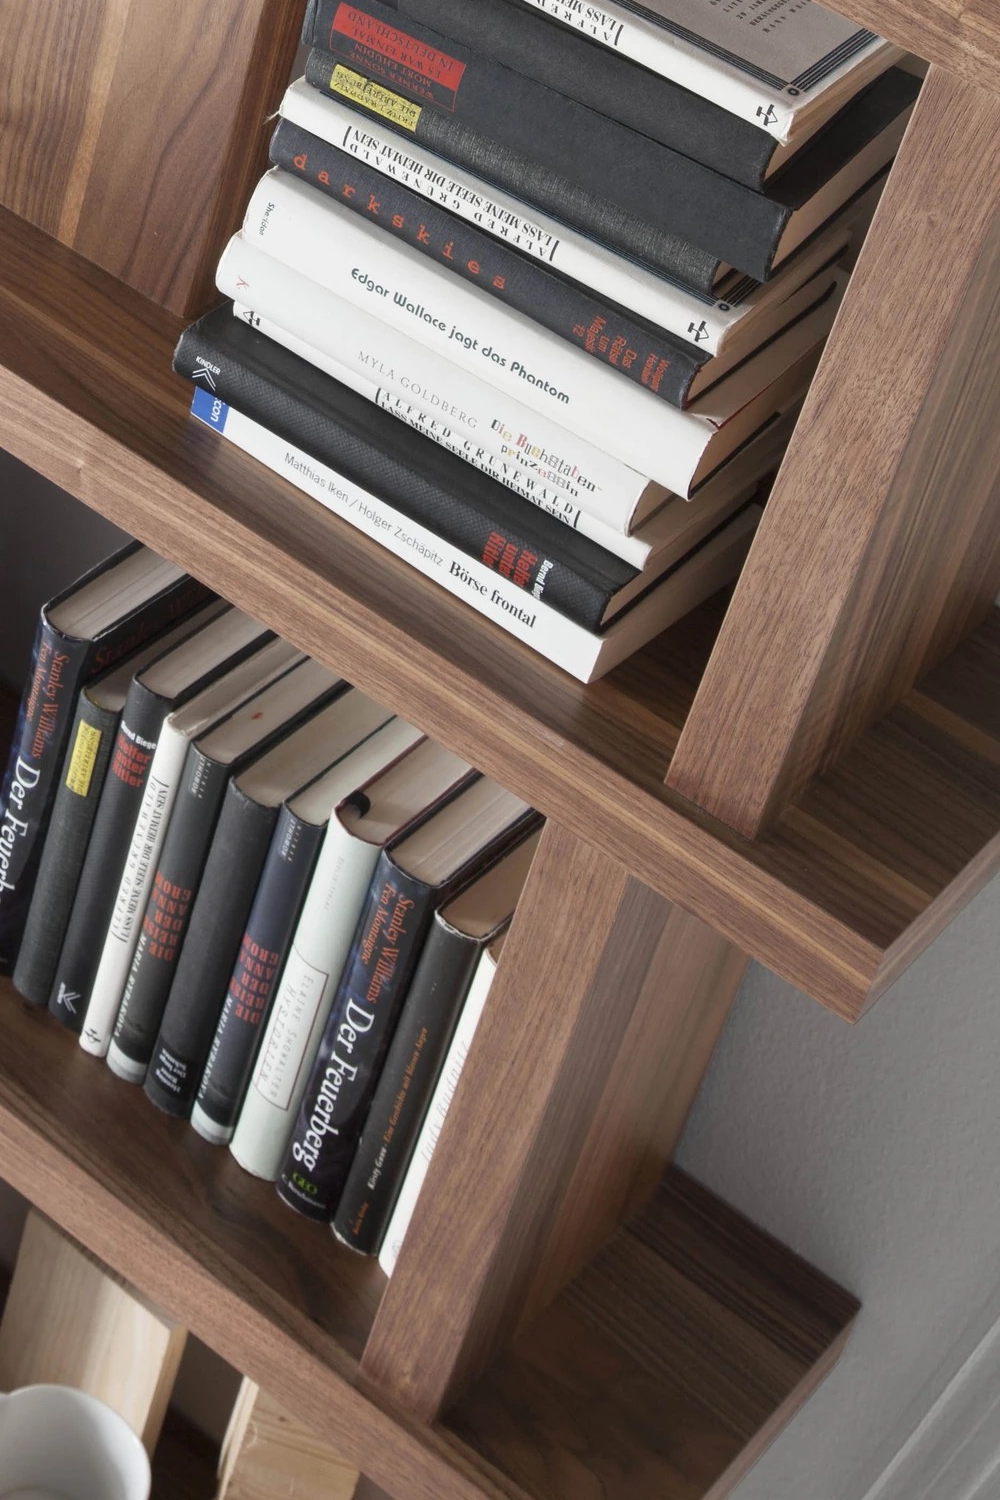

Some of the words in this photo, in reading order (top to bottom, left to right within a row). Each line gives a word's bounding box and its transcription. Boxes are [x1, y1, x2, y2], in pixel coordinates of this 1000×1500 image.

[586, 7, 617, 30] LASS
[348, 11, 438, 63] DEUTSCHLAND
[353, 28, 397, 57] EINMAL
[399, 52, 423, 70] WAR
[426, 64, 441, 79] ES
[439, 57, 454, 70] IN
[353, 130, 380, 151] SEIN
[380, 143, 424, 174] HEIMAT
[350, 143, 460, 209] GRÜNEWALD
[424, 166, 447, 187] DIR
[448, 178, 484, 206] SEELE
[484, 197, 521, 227] MEINE
[473, 212, 548, 257] ALFRED
[523, 217, 554, 246] LASS
[351, 267, 390, 298] Edgar
[393, 292, 446, 332] Wallace
[448, 326, 480, 351] jagt
[481, 347, 507, 368] das
[509, 361, 570, 405] Phantom
[573, 324, 584, 337] 12
[598, 333, 609, 352] um
[608, 335, 626, 365] Rätsel
[622, 349, 637, 369] Das
[195, 355, 221, 376] KINDLER
[359, 351, 395, 380] MYLA
[400, 377, 478, 430] GOLDBERG
[491, 419, 512, 442] Die
[382, 391, 452, 438] ALFRED
[284, 452, 325, 488] Matthias
[328, 481, 349, 503] Iken
[358, 501, 393, 534] Holger
[393, 526, 443, 567] Zschäpitz
[449, 560, 488, 597] Börse
[490, 588, 537, 628] frontal
[537, 558, 554, 586] Bernd
[42, 651, 69, 701] Stanley
[31, 703, 59, 760] Williams
[10, 755, 41, 811] Der
[121, 921, 133, 941] LASS
[127, 889, 141, 921] MEINE
[135, 860, 149, 890] SEELE
[147, 807, 163, 843] HEIMAT
[156, 790, 169, 811] SEIN
[383, 881, 398, 904] Fen
[384, 893, 415, 936] Stanley
[361, 902, 391, 965] Montaigne
[366, 946, 401, 1004] Williams
[337, 997, 375, 1055] Der
[292, 1051, 359, 1173] Feuerberg
